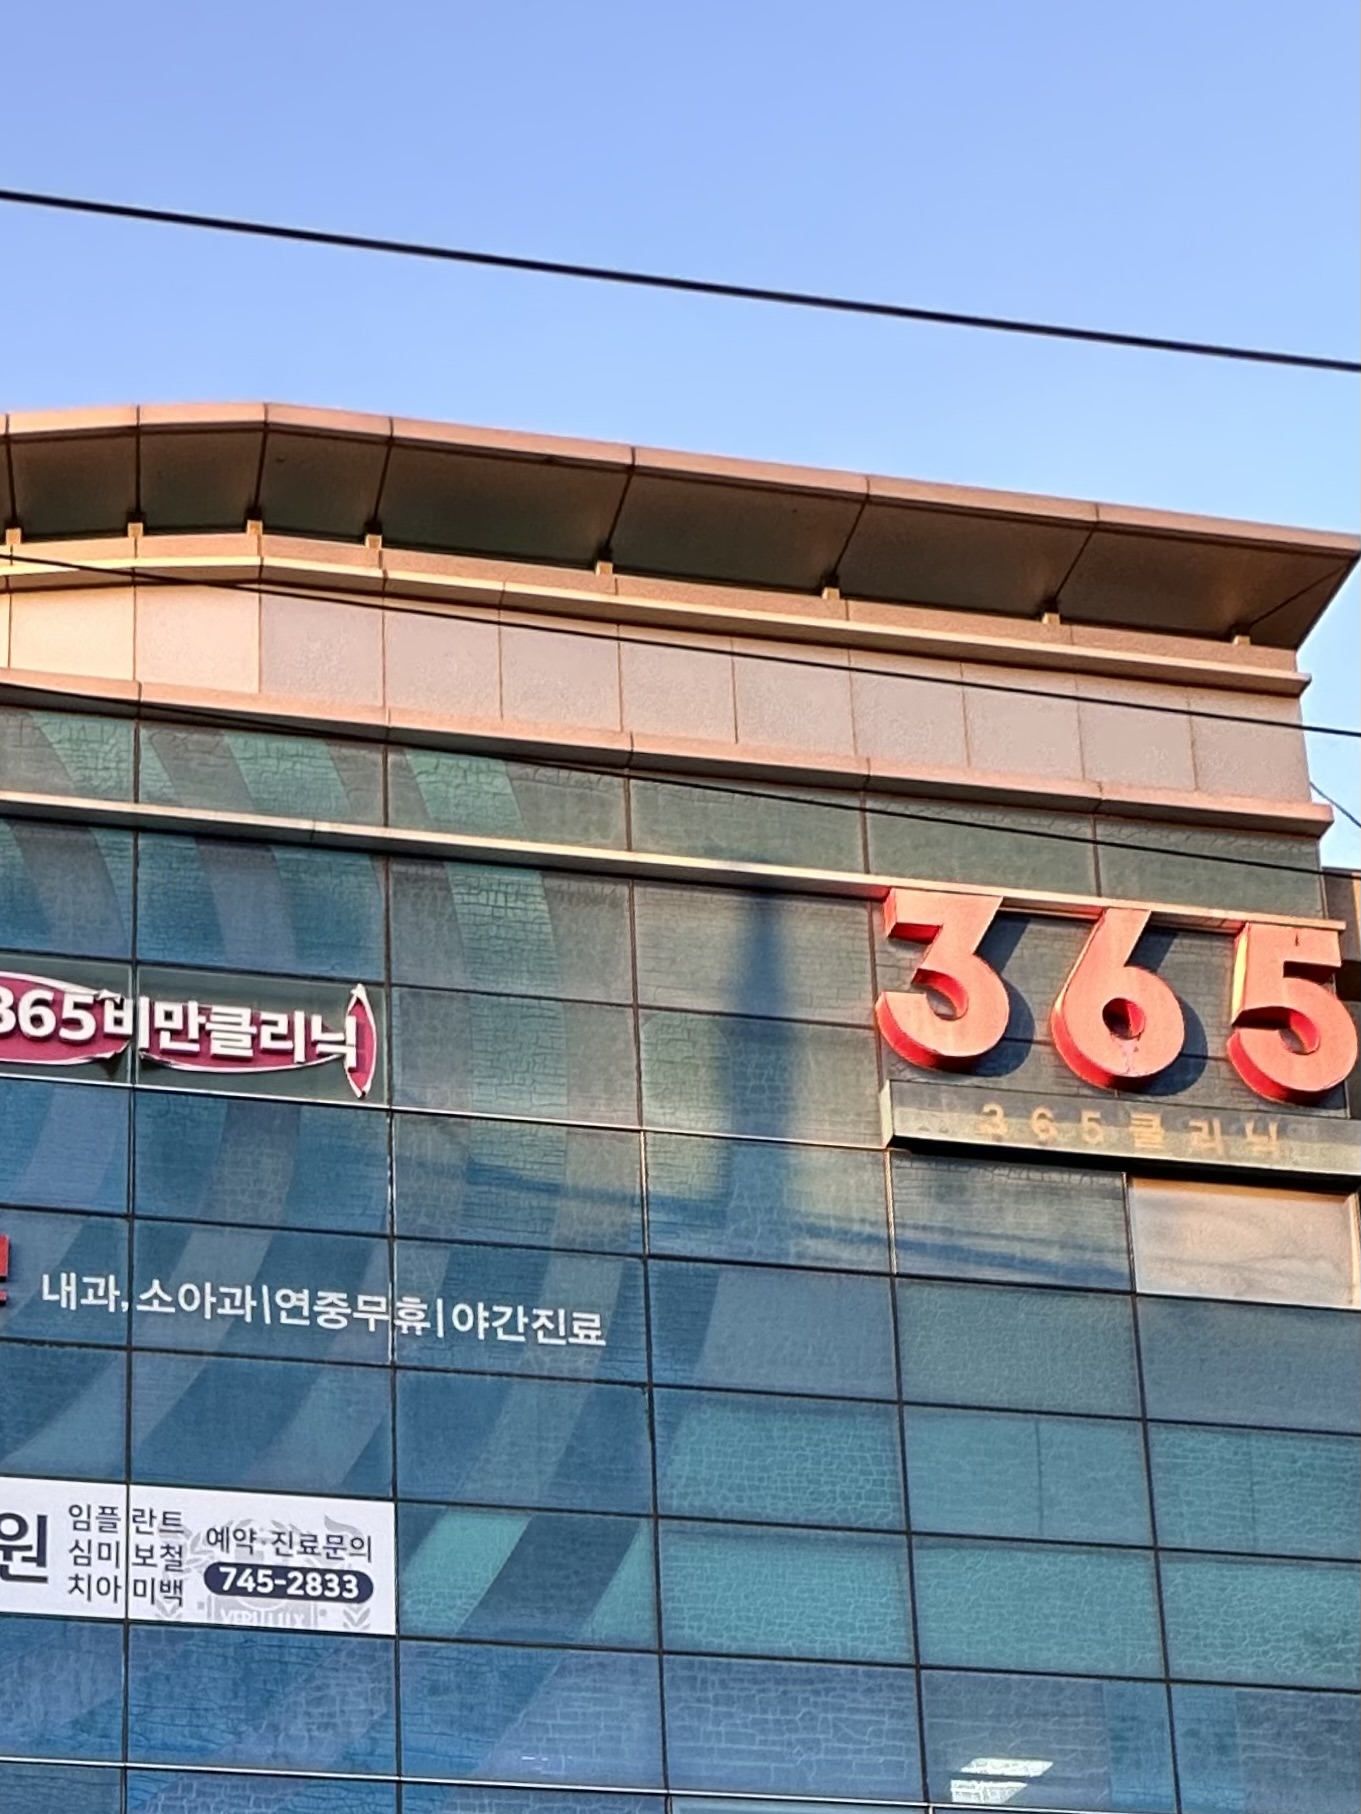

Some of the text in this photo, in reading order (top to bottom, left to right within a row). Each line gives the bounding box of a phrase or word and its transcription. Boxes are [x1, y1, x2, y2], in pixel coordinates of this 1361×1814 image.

[875, 888, 1359, 1106] 365
[451, 1301, 607, 1346] 야간진료
[67, 1503, 185, 1537] 임플란트
[217, 1566, 361, 1600] 745-2833
